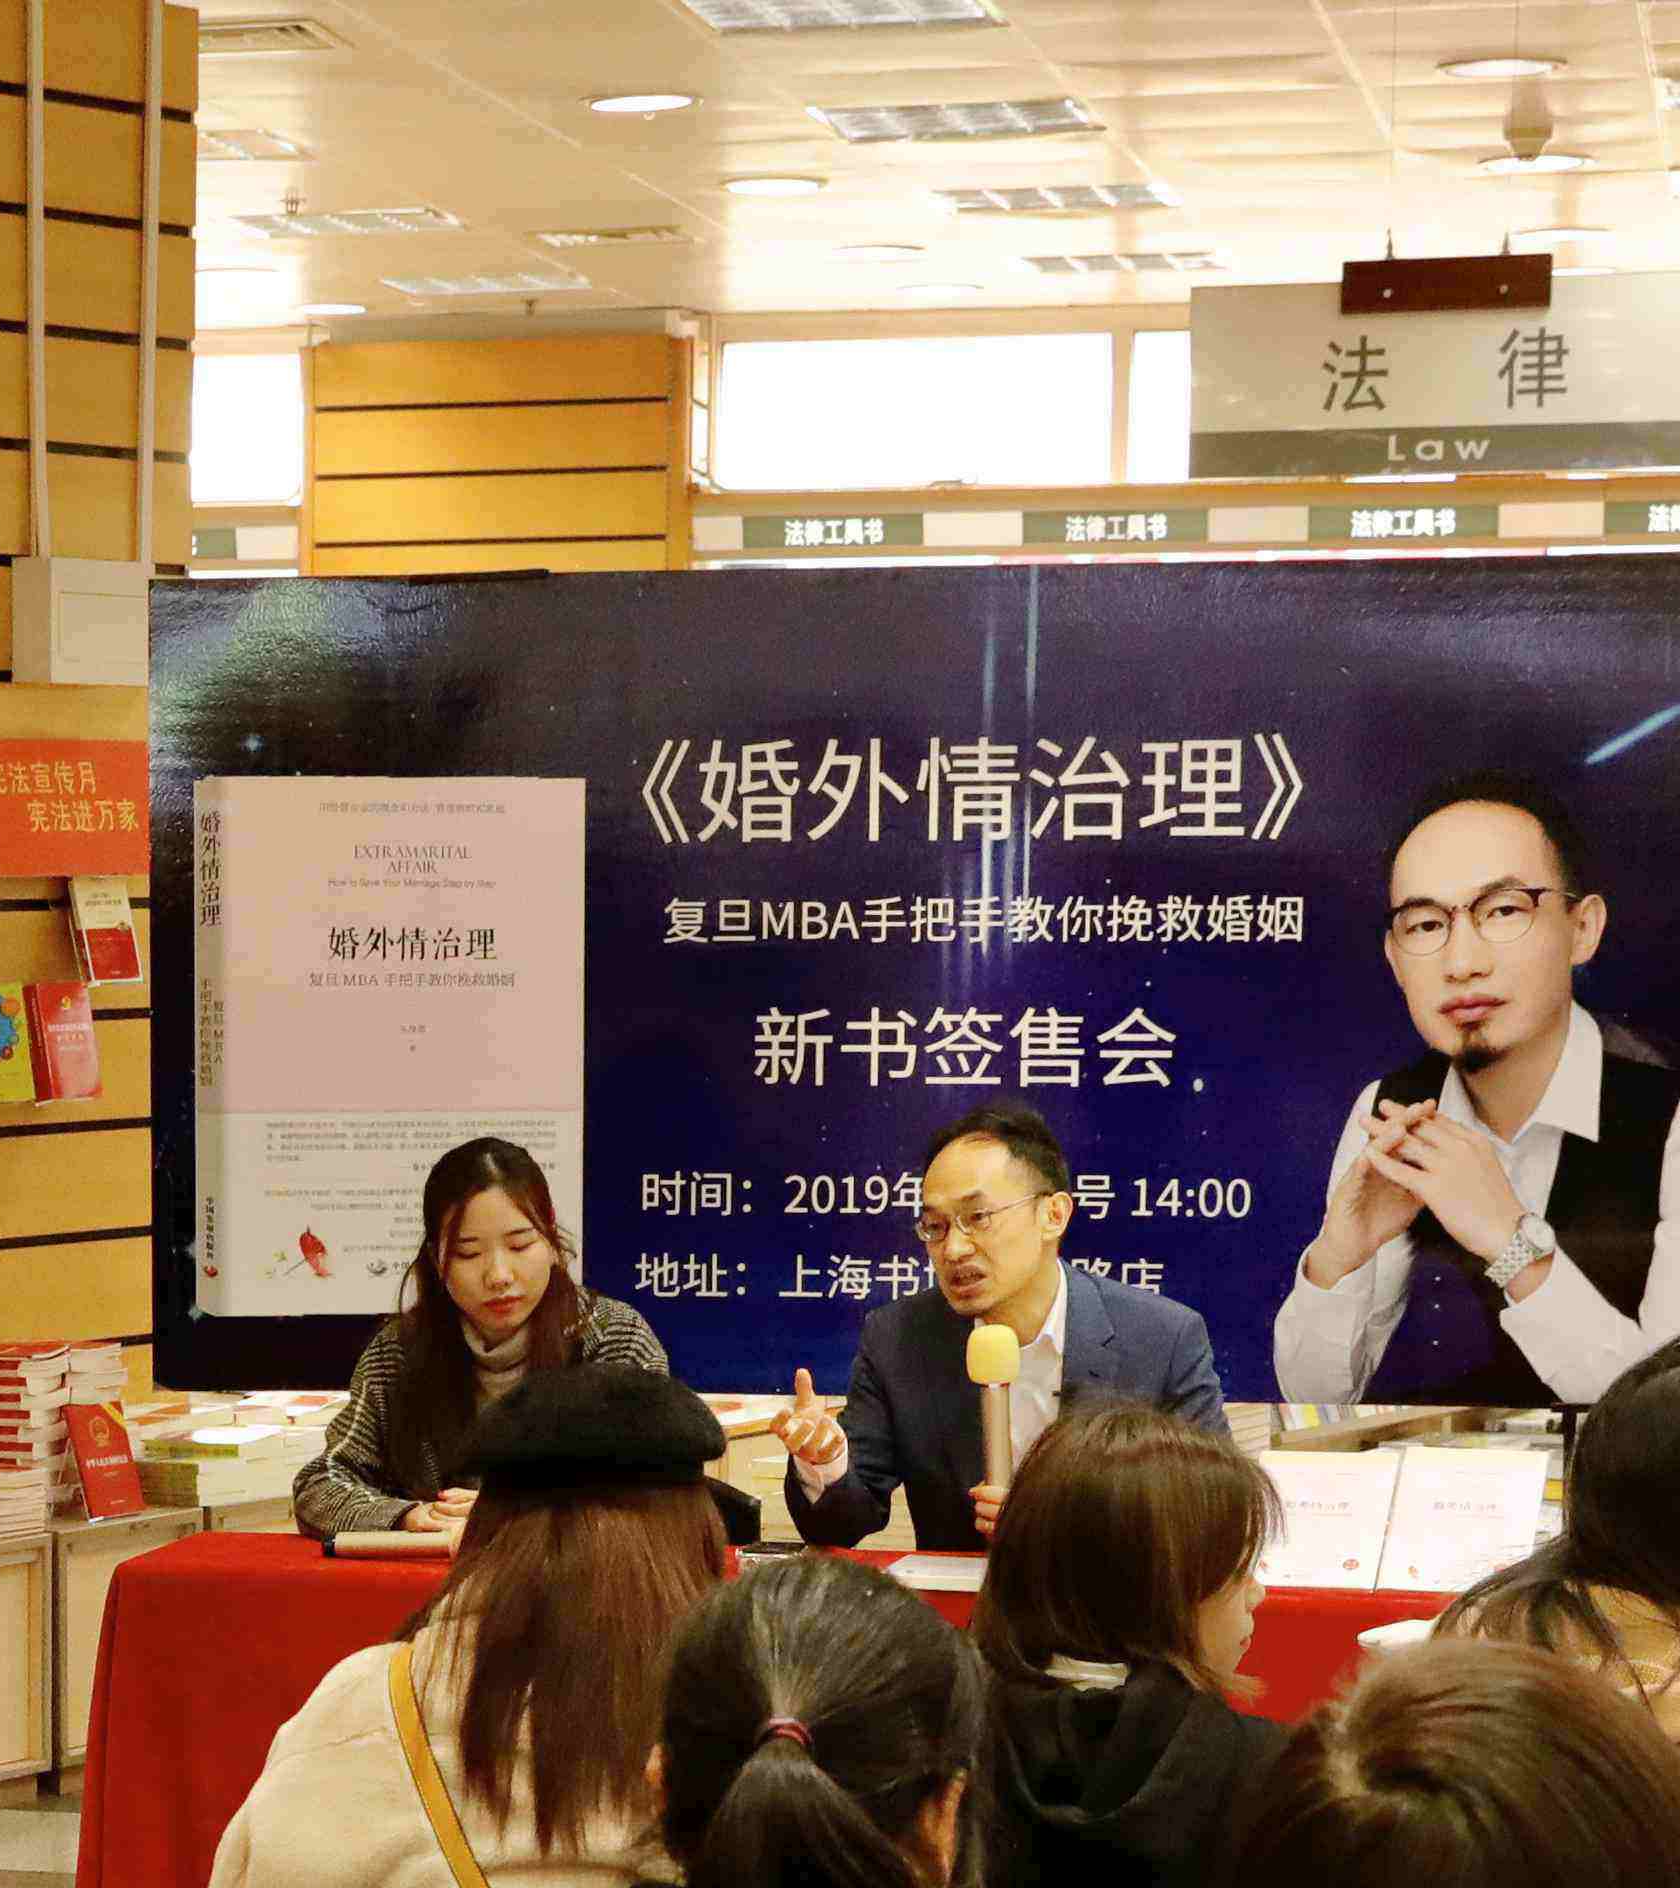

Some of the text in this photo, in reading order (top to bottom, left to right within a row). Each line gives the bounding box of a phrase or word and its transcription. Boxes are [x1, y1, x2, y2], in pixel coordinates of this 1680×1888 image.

[1320, 327, 1571, 412] 法律
[1387, 434, 1490, 463] Law
[783, 519, 885, 548] 法律工具书
[1065, 514, 1167, 543] 法律工具书
[641, 732, 1303, 844] 《婚外情治理》
[27, 799, 139, 833] 宪法进万家
[199, 810, 223, 928] 婚外情治理
[353, 844, 472, 860] EXTRAMARITAL
[387, 860, 439, 874] AFFAIR
[663, 895, 1304, 944] 复旦MBA手把手教你挽救婚姻
[328, 926, 498, 961] 婚外情治理
[753, 1007, 1177, 1088] 新书签售会
[1130, 1178, 1252, 1219] 14:00
